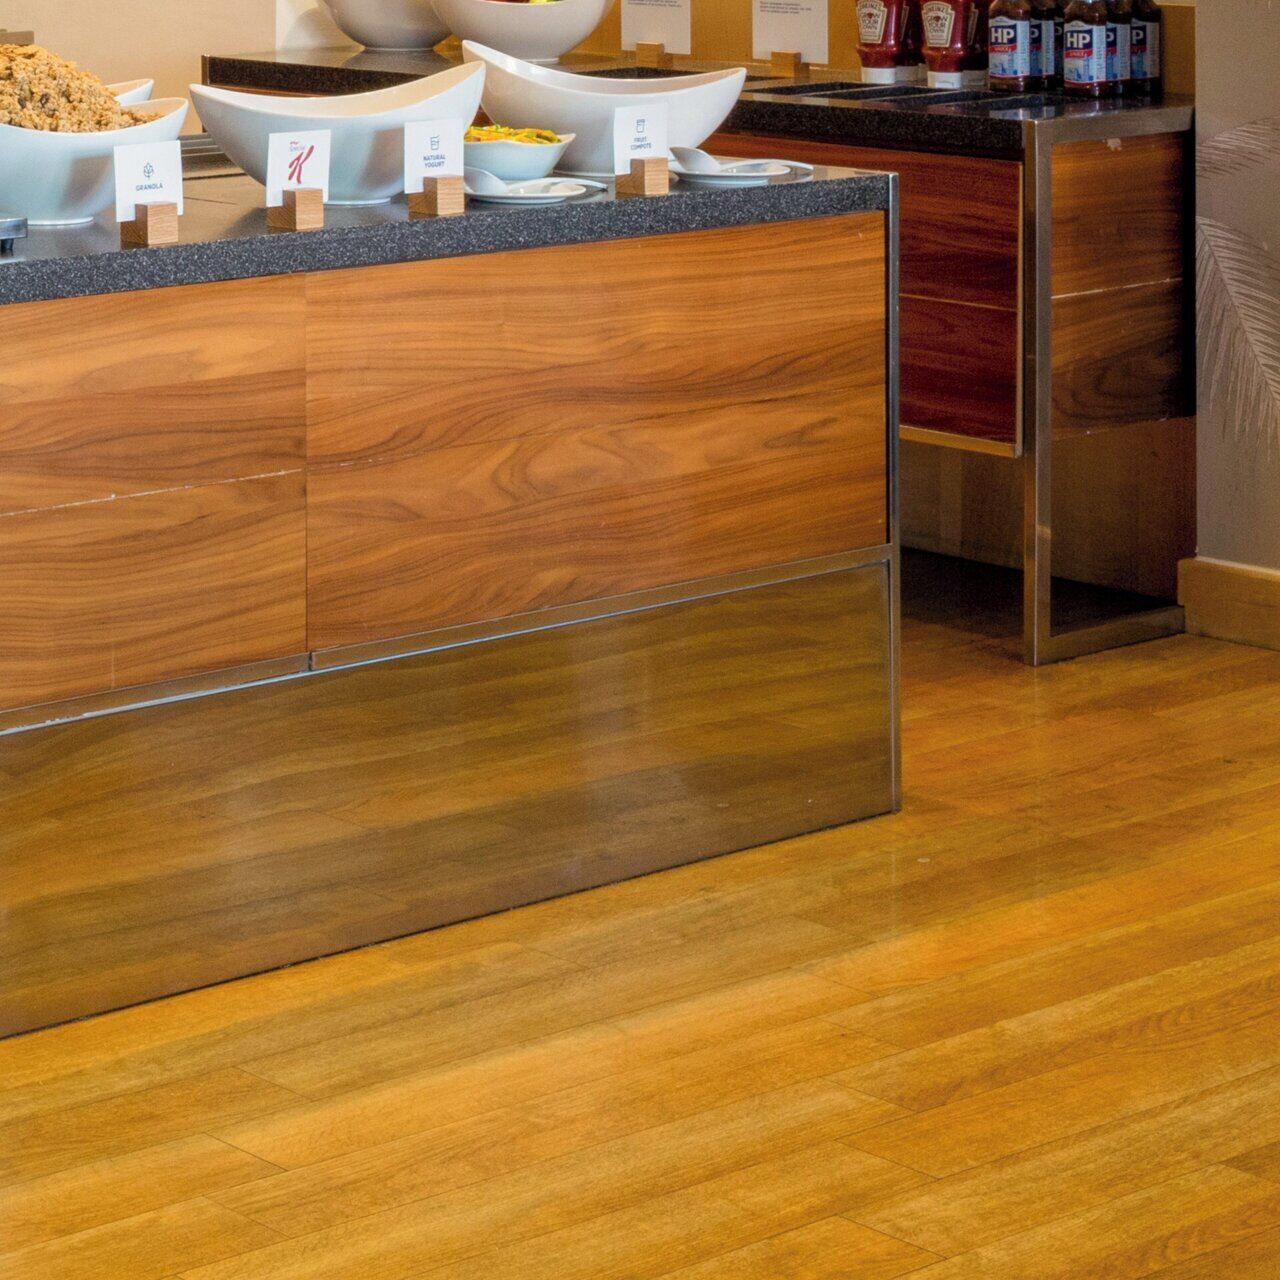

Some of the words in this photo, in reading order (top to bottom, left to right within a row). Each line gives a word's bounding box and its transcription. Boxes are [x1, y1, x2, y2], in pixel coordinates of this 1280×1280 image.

[991, 27, 1015, 43] HP
[1066, 32, 1091, 48] HP
[288, 144, 315, 184] K
[135, 183, 163, 191] GRANOLA
